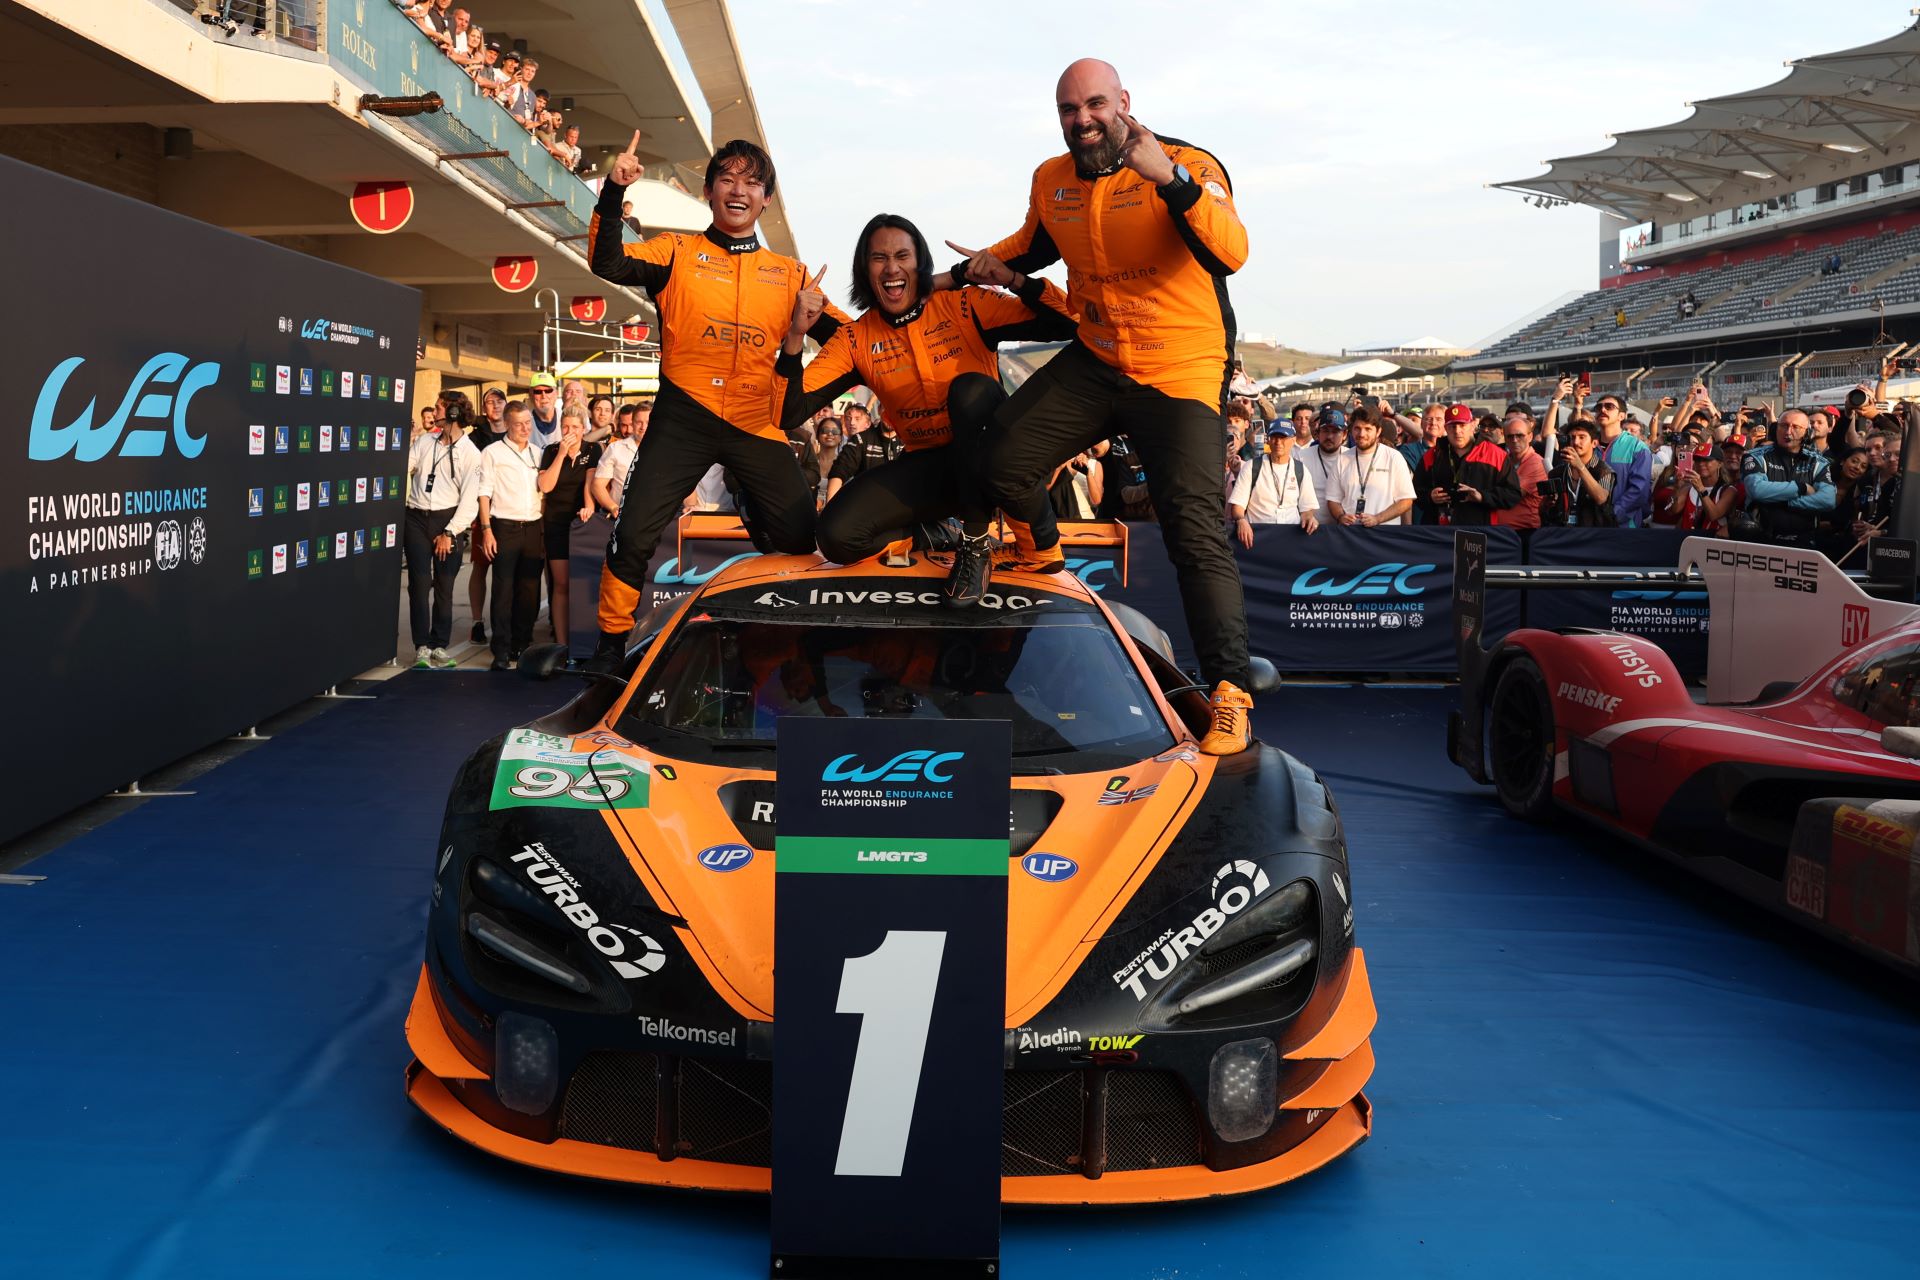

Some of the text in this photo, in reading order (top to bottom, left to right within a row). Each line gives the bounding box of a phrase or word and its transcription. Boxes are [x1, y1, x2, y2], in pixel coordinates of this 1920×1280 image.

[342, 22, 376, 71] ROLEX
[401, 72, 425, 97] ROLE
[376, 188, 386, 221] 1
[510, 260, 521, 283] 2
[584, 301, 594, 318] 3
[301, 319, 330, 341] WEC
[331, 332, 359, 345] CHAMPIONSHIP
[338, 323, 352, 333] WORLD
[352, 325, 374, 338] ENDURANCE
[631, 327, 639, 339] 4
[702, 325, 765, 348] AERO
[924, 320, 953, 336] WEC
[933, 347, 963, 366] Aladin
[1135, 342, 1165, 351] LEUNG
[741, 383, 758, 391] SATO
[28, 352, 221, 462] WEC
[905, 425, 950, 438] Telkom
[29, 487, 207, 523] FIA WORLD ENDURANCE
[29, 522, 152, 560] CHAMPIONSHIP
[156, 530, 179, 561] FIA
[1464, 539, 1482, 555] Ansys
[1706, 548, 1819, 578] PORSCHE
[1881, 547, 1911, 560] RACEBORN
[30, 558, 152, 593] A PARTNERSHIP
[1291, 563, 1436, 596] WEC
[1774, 575, 1818, 593] 963
[653, 591, 671, 599] FIA
[809, 589, 940, 605] Invesc
[1290, 603, 1424, 611] FIA WORLD ENDURANCE
[1290, 612, 1377, 620] CHAMPIONSHIP
[1612, 607, 1710, 616] FIA WORLD ENDUR
[1381, 614, 1400, 626] FIA
[1612, 616, 1697, 624] CHAMPIONSHIP
[1843, 607, 1868, 644] HY
[1600, 641, 1662, 688] Ansys
[1223, 695, 1245, 704] Leung
[1557, 681, 1623, 713] PENSKE
[822, 750, 965, 783] WEC
[509, 766, 634, 803] 95
[822, 789, 954, 799] FIA WORLD ENDURANCE
[821, 798, 907, 808] CHAMPIONSHIP
[1840, 811, 1908, 850] DHL
[531, 842, 582, 889] PERTAMAX
[703, 849, 749, 865] UP
[857, 850, 928, 862] LMGT3
[1029, 857, 1072, 876] UP
[510, 845, 625, 957] TURBO
[1788, 876, 1823, 914] CAR
[1119, 885, 1251, 1002] TURBO
[1112, 928, 1175, 984] PERTAMAX
[638, 1016, 736, 1047] Telkomsel
[1018, 1027, 1081, 1050] Aladin
[834, 930, 947, 1177] 1
[1089, 1035, 1128, 1051] TOW
